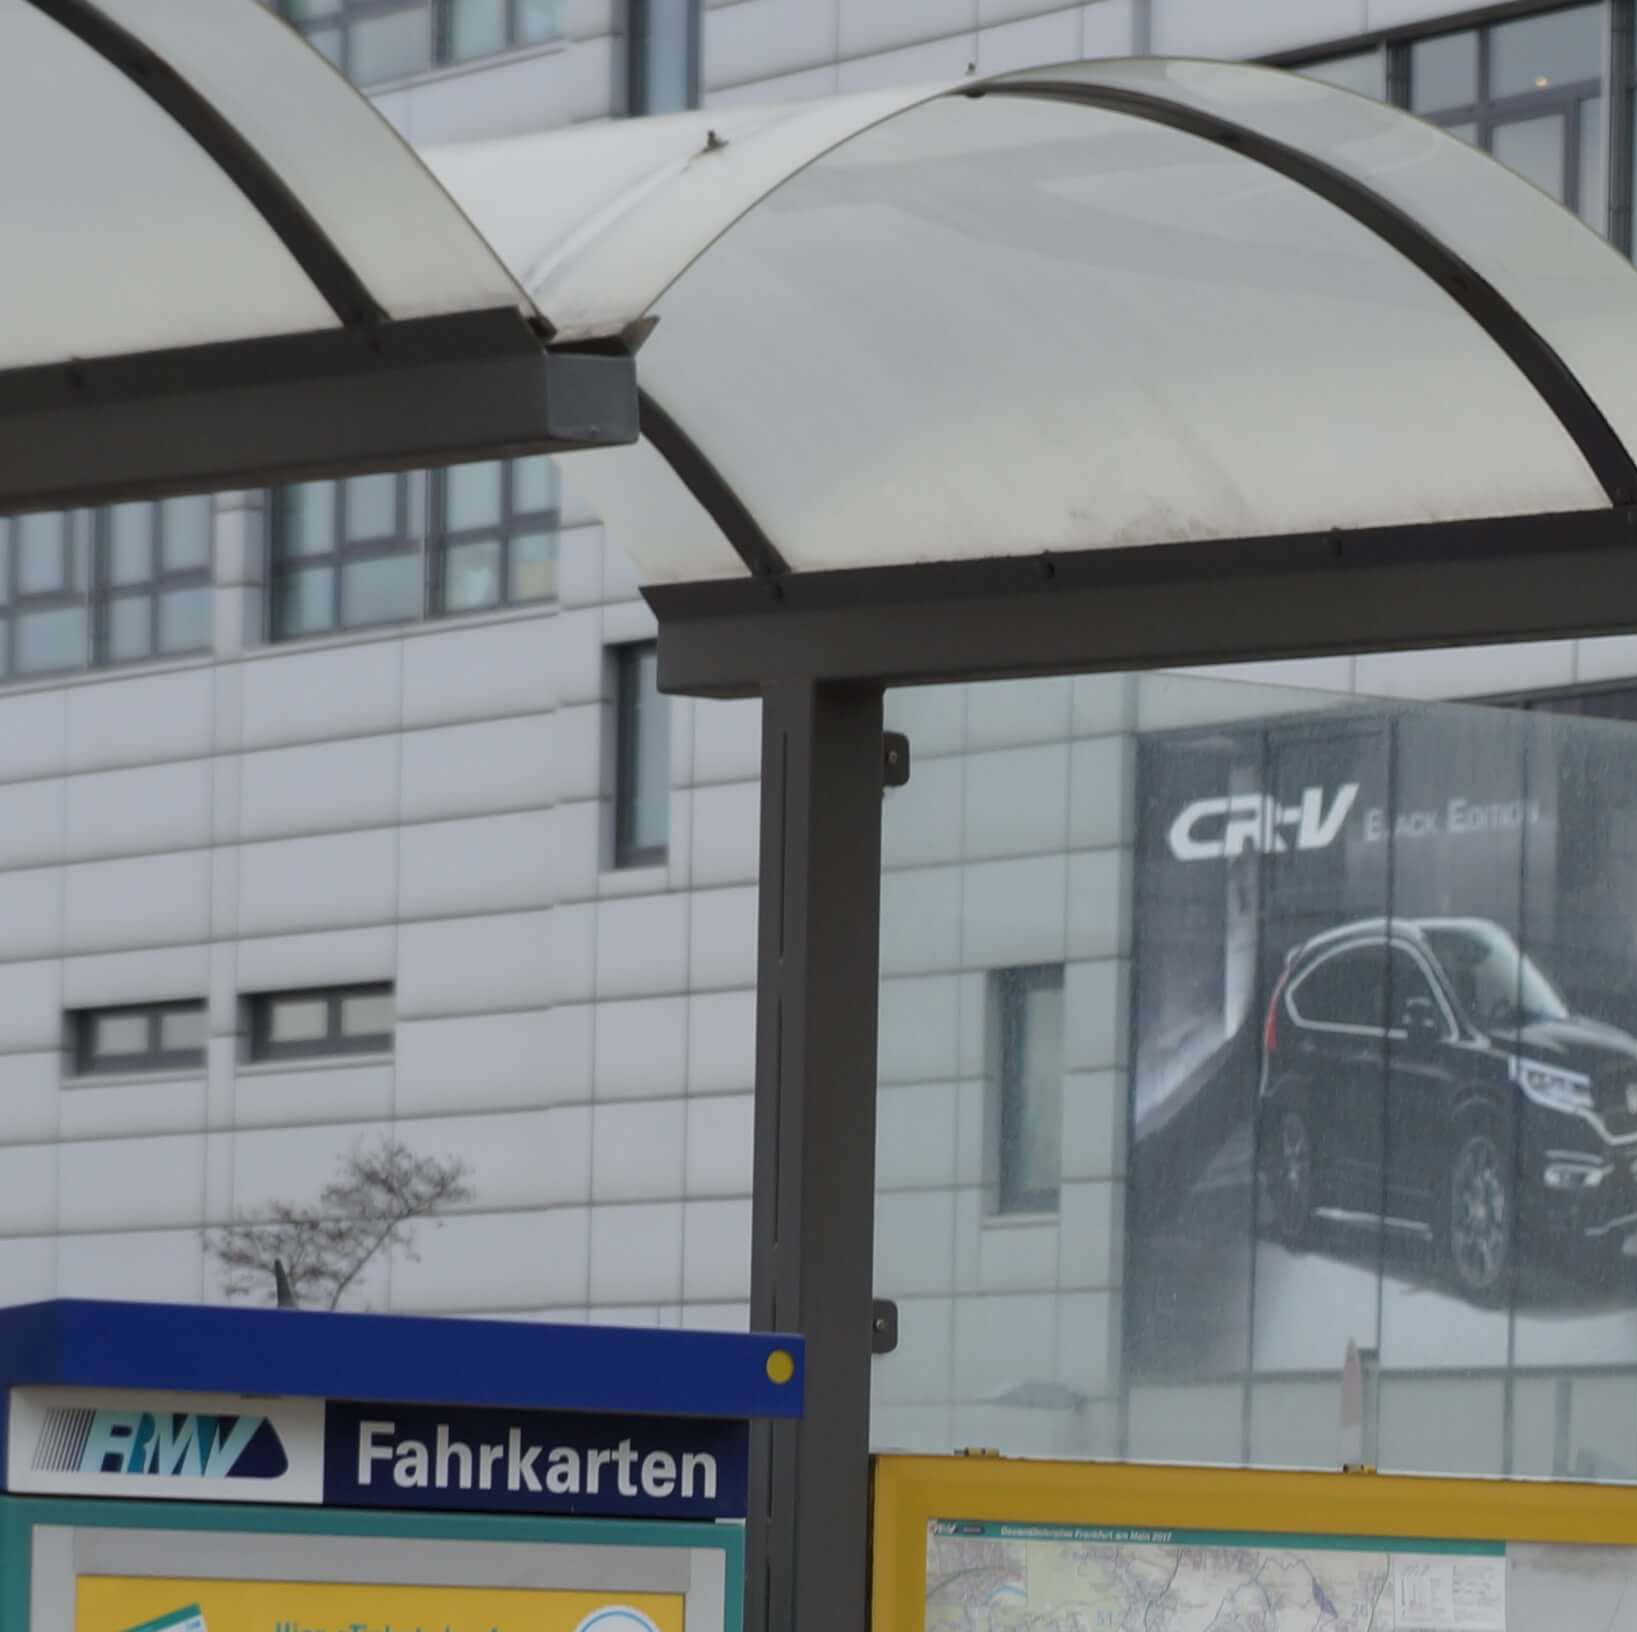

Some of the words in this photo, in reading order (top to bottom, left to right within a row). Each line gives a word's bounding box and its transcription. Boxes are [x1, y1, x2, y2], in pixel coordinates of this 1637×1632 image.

[1170, 783, 1359, 861] CR-V
[78, 1408, 262, 1478] RMV
[357, 1420, 717, 1499] Fahrkarten
